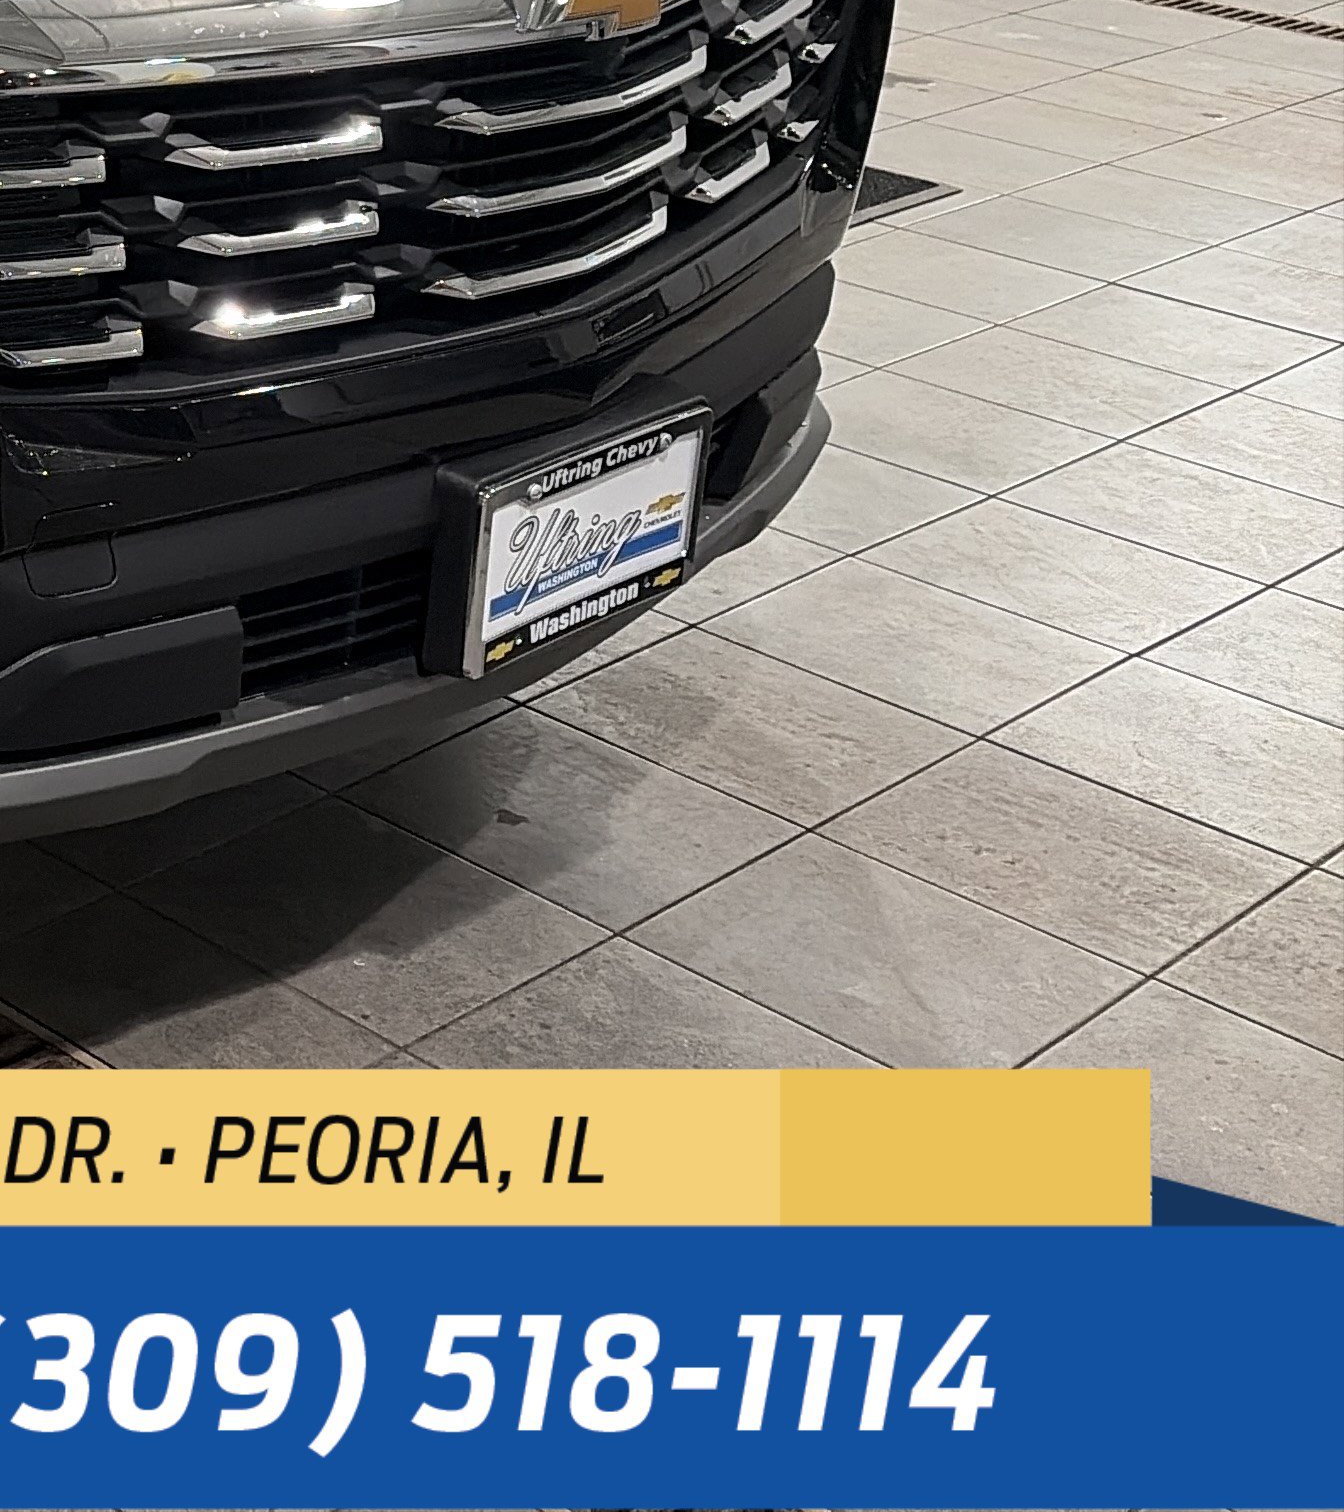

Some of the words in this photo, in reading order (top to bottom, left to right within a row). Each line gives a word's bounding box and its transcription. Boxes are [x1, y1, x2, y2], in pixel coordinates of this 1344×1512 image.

[541, 456, 603, 493] Uftring
[606, 435, 660, 467] Chevy
[643, 510, 682, 530] CHEVROLET
[537, 557, 599, 594] WASHINGTON
[530, 581, 640, 644] Washington
